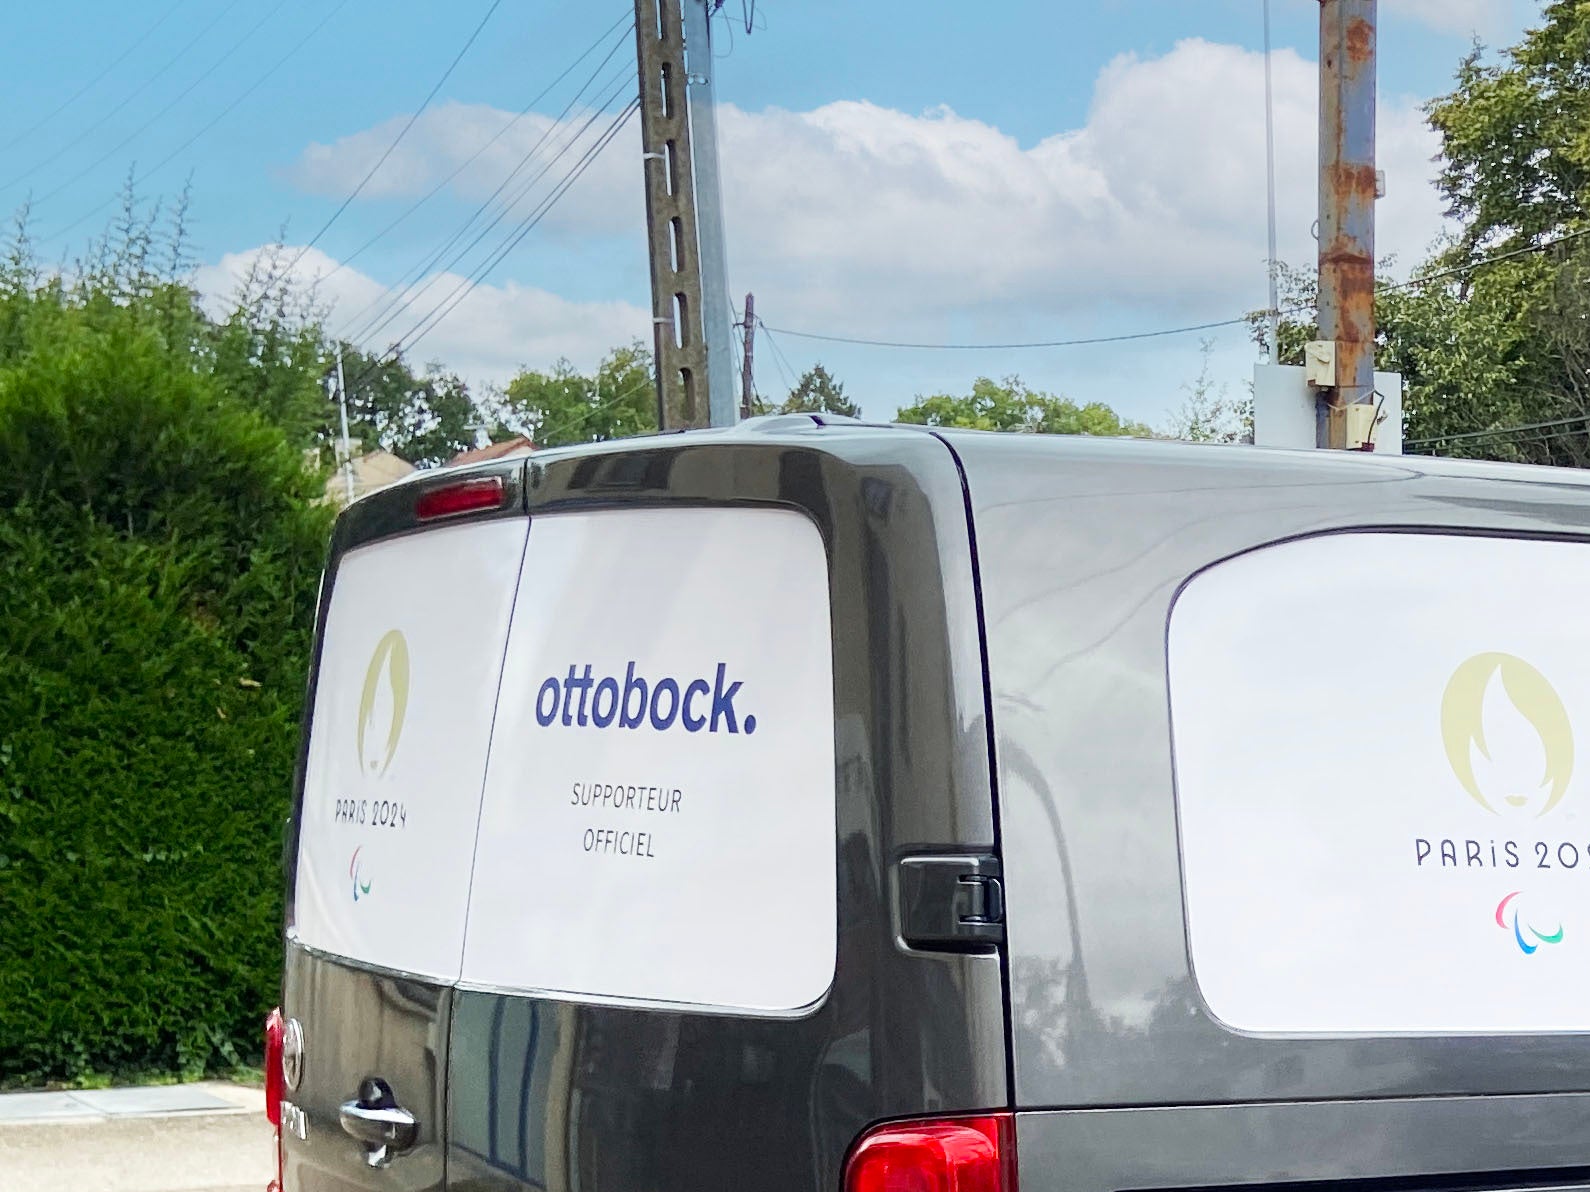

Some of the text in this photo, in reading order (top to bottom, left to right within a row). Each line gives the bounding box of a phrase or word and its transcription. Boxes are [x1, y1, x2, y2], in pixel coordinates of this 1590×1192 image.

[535, 660, 757, 735] ottobock.
[570, 782, 682, 813] SUPPORTEUR
[371, 800, 407, 828] 2024
[583, 828, 655, 858] OFFICIEL
